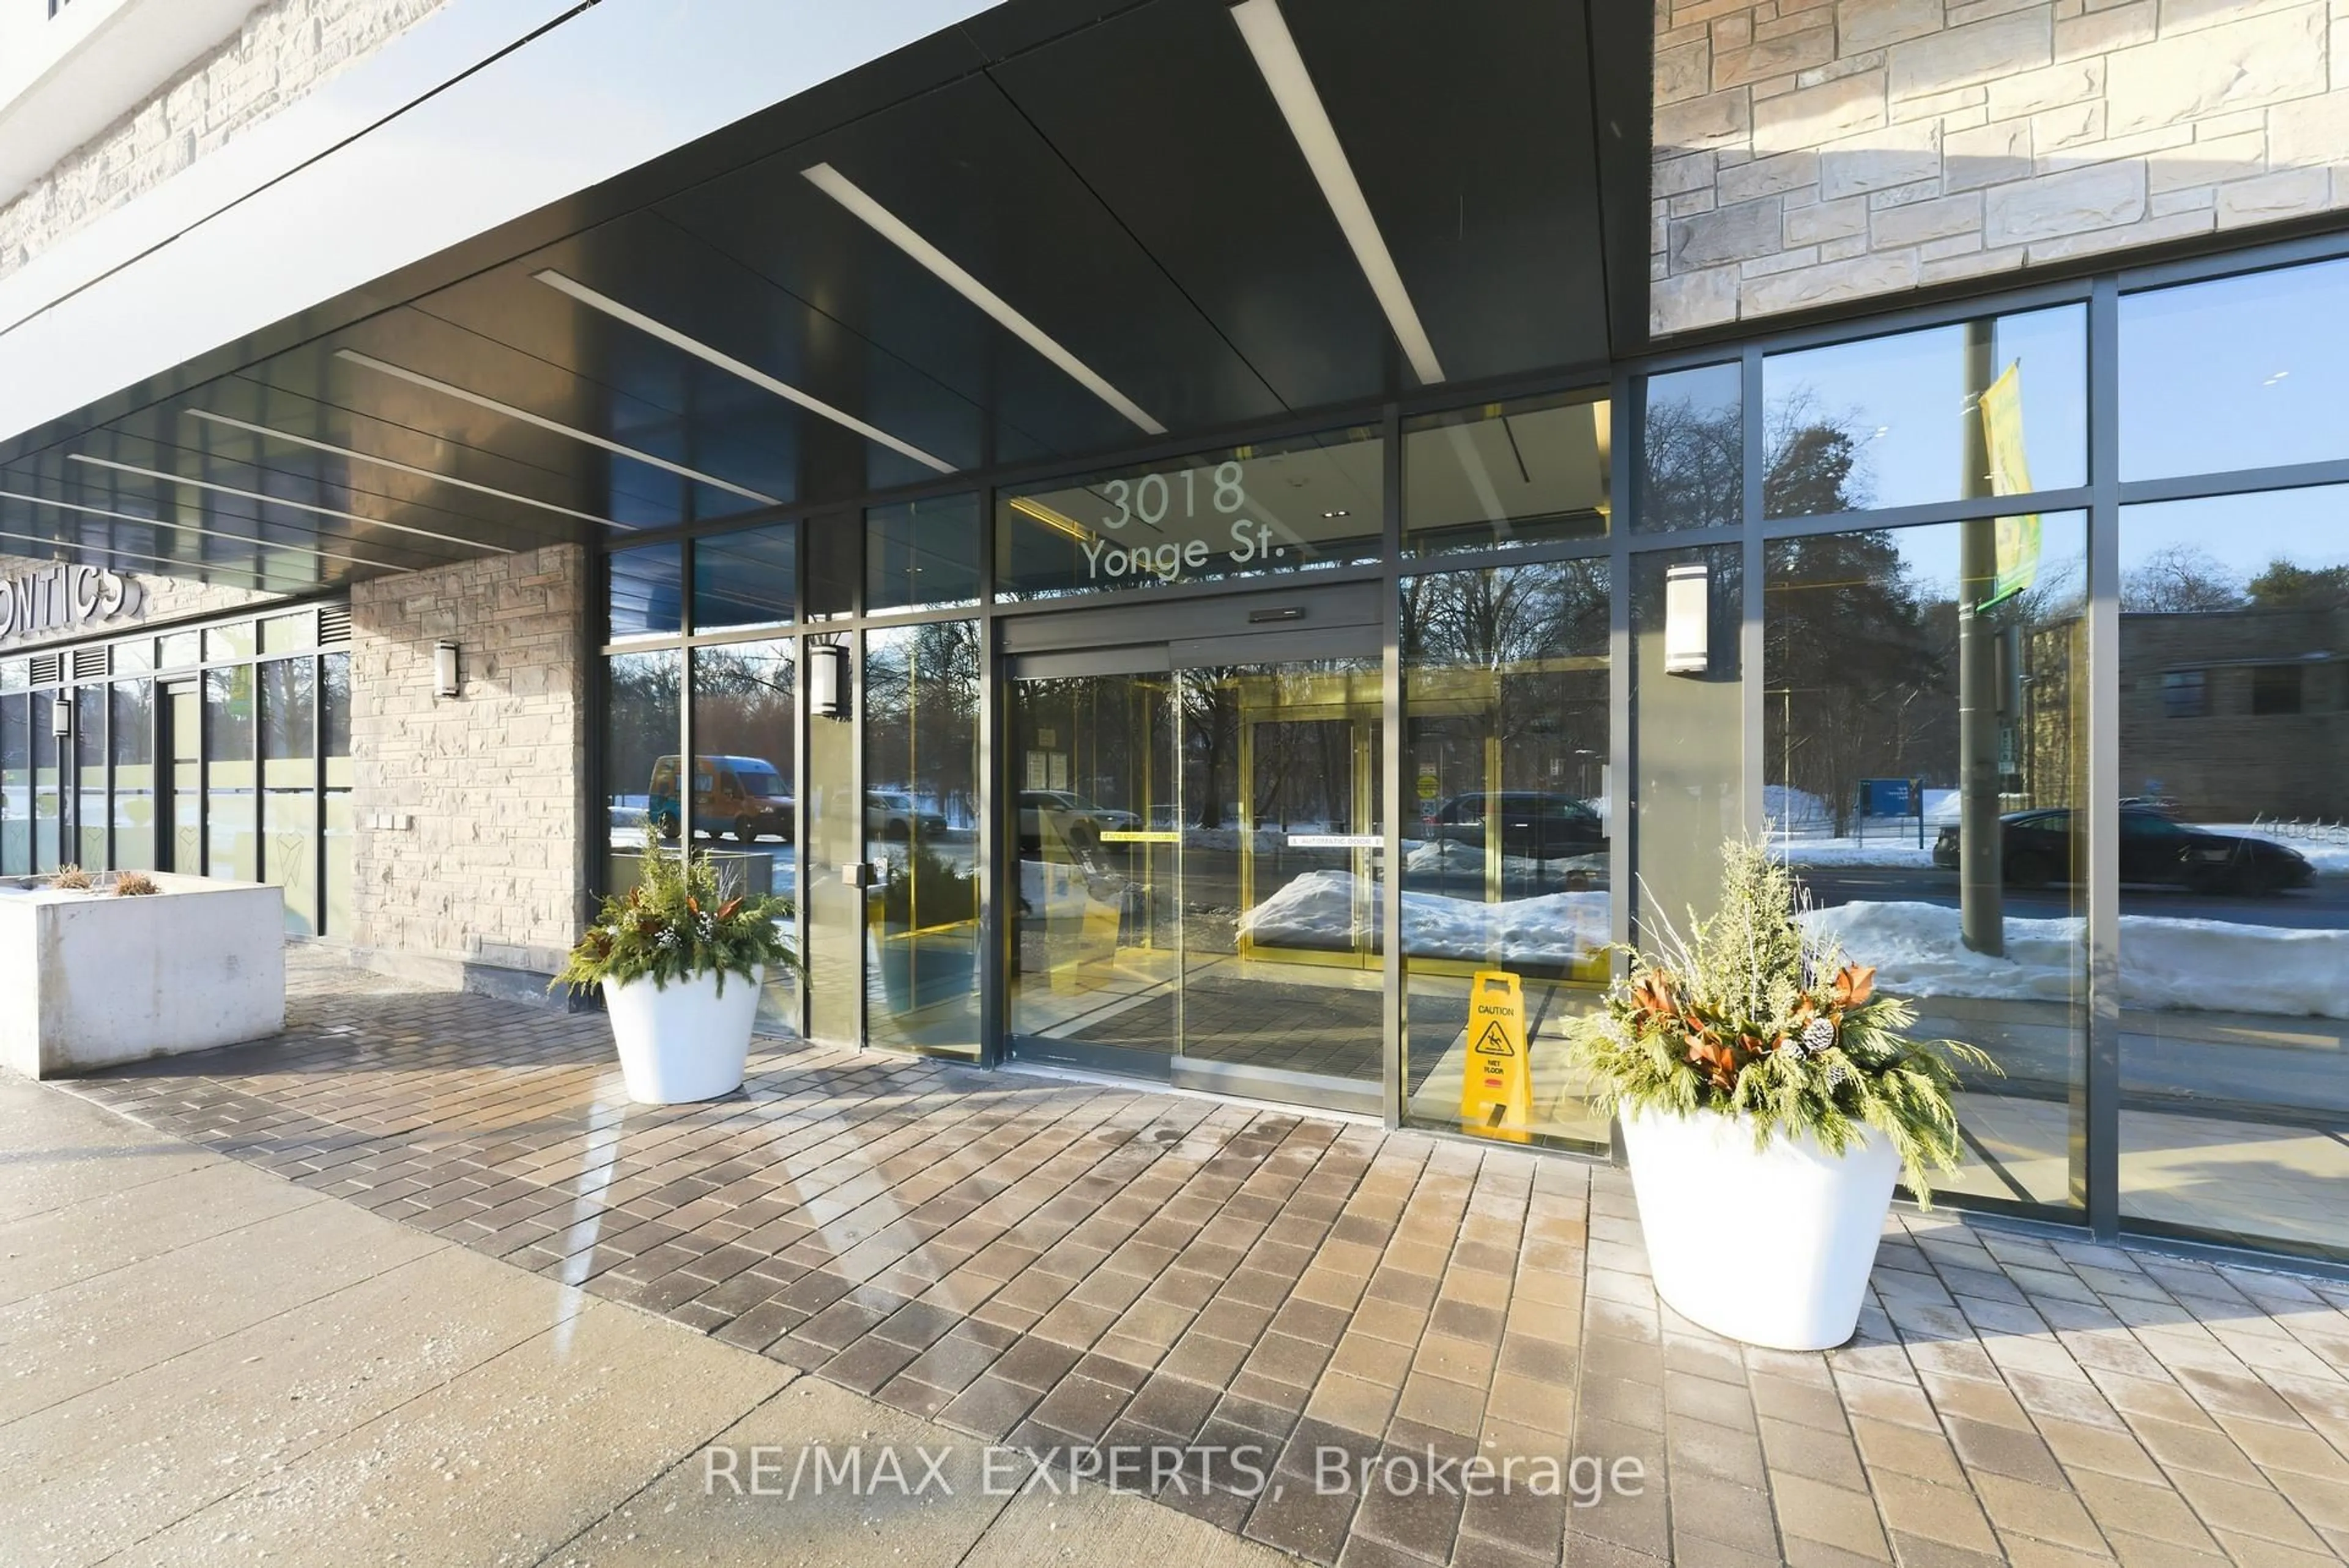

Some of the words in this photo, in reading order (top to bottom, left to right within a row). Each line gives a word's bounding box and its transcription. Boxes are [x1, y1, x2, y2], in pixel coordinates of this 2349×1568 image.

[1103, 461, 1245, 529] 3018
[1081, 539, 1209, 581] Yonge
[1230, 519, 1284, 563] St.
[1478, 1005, 1514, 1015] CAUTION
